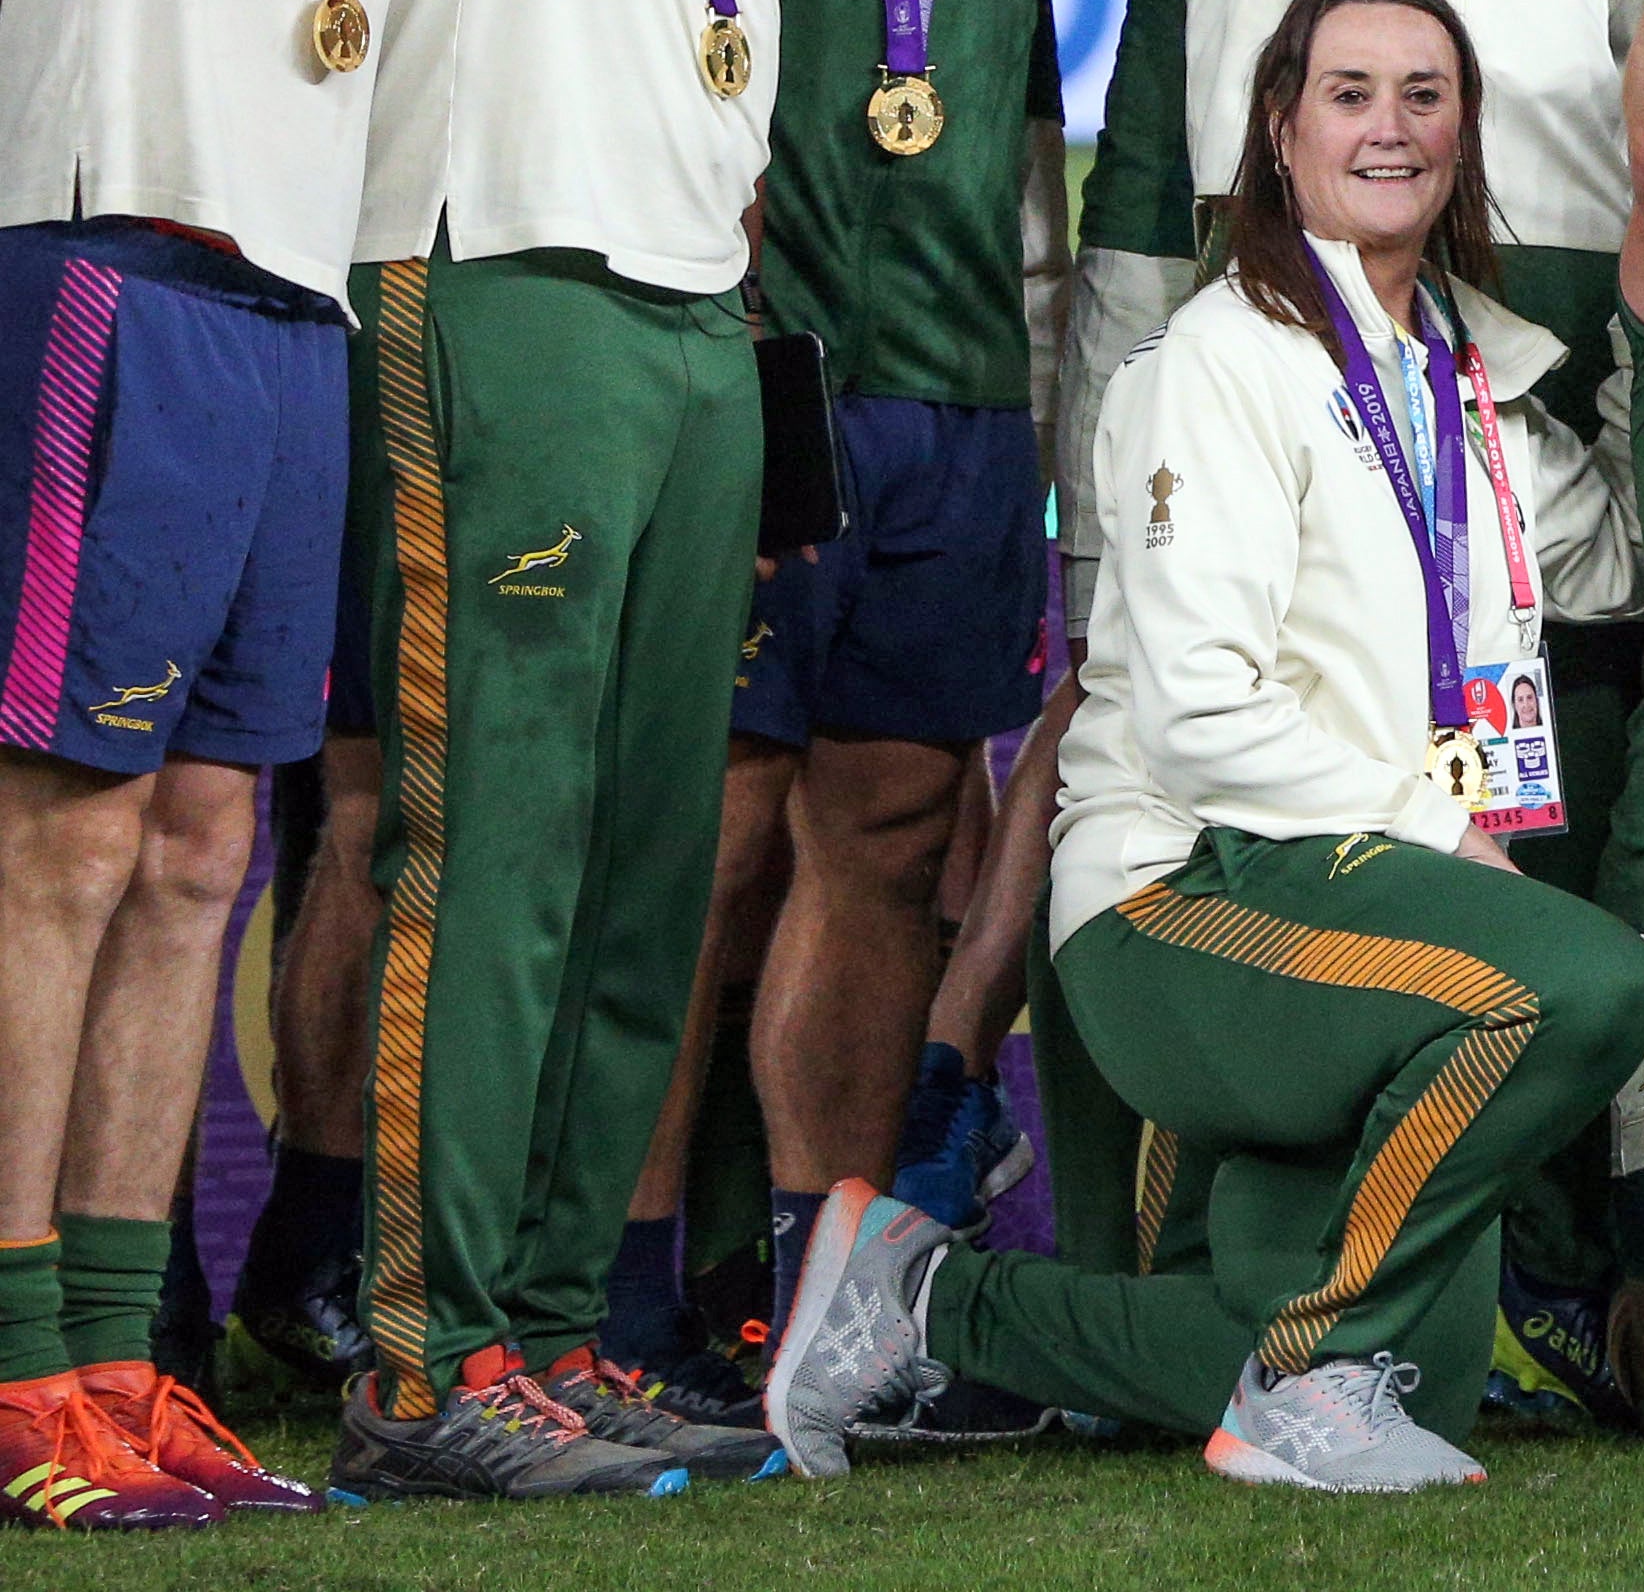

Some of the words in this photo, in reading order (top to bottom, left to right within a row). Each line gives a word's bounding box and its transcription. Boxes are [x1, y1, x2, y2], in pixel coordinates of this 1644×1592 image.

[1415, 421, 1434, 486] RUGBY
[1146, 523, 1175, 536] 1995
[1145, 535, 1175, 549] 2007
[498, 583, 567, 598] SPRINGBOK
